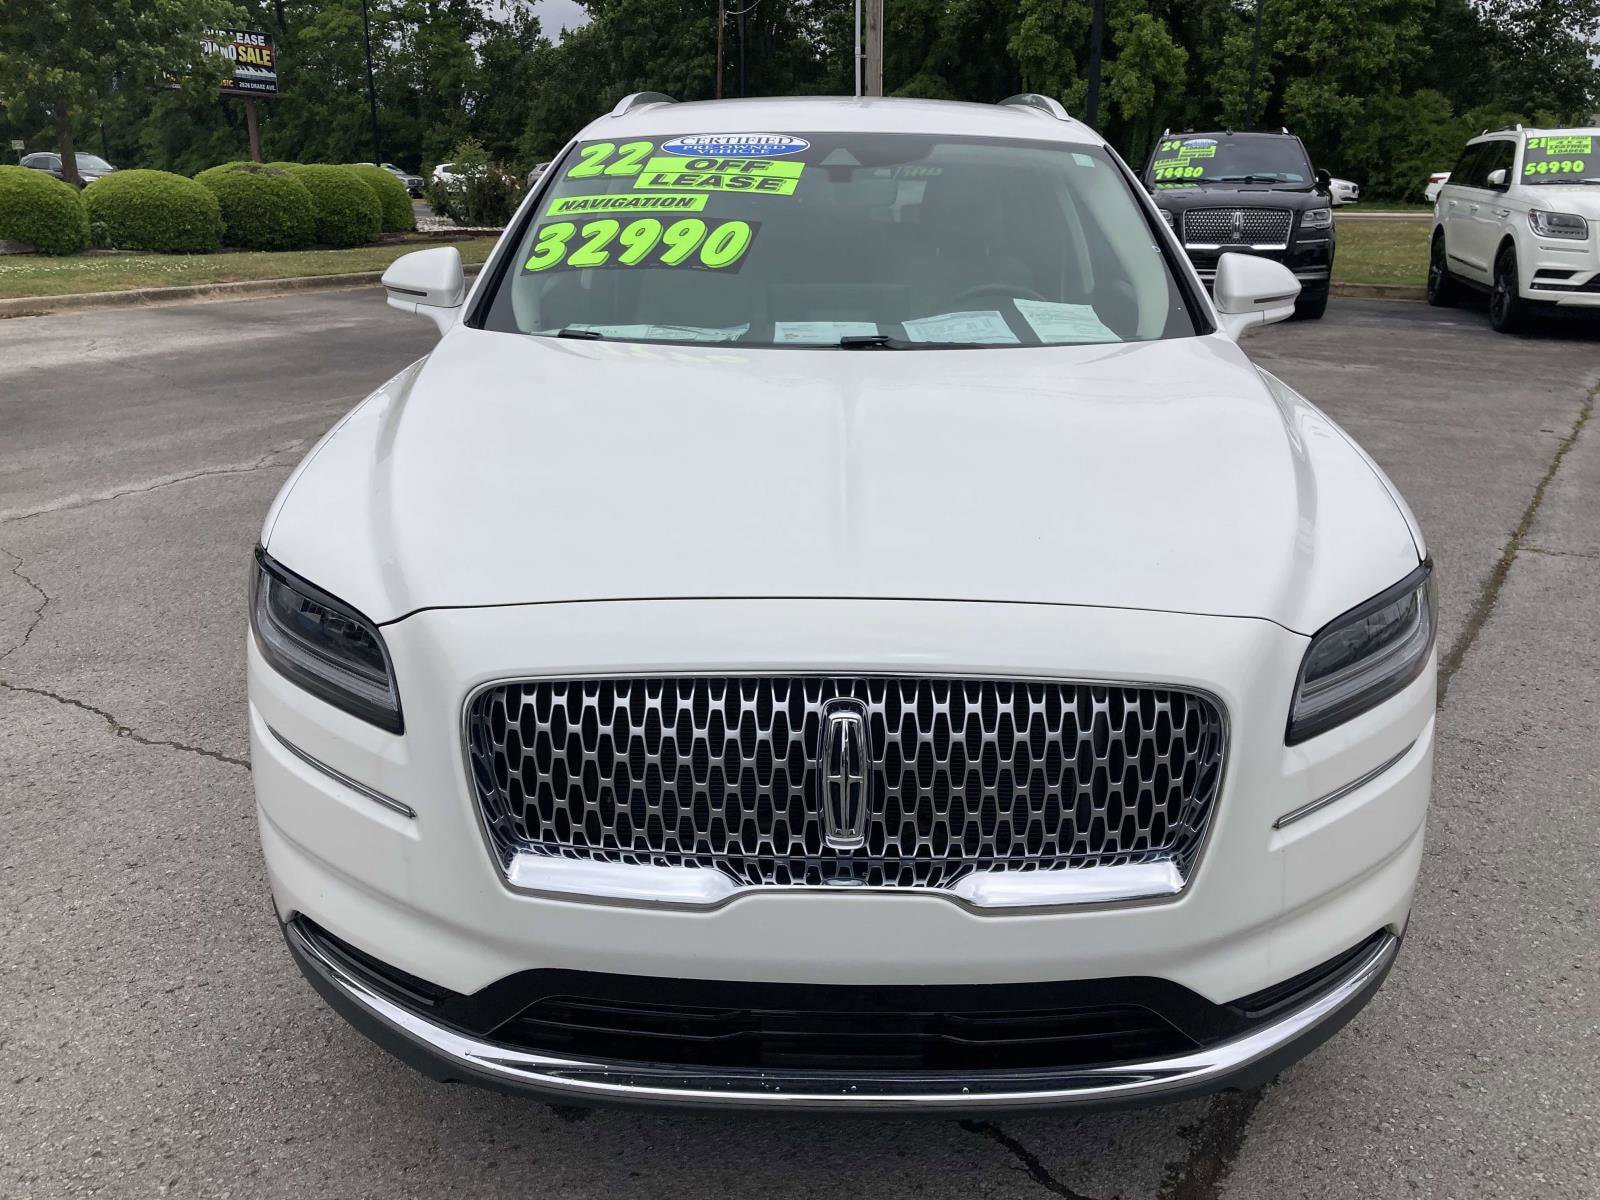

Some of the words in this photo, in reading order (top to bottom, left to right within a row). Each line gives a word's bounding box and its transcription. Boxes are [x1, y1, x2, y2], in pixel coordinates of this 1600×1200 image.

[238, 45, 272, 66] SALE
[680, 136, 794, 145] CERTIFIED
[1161, 141, 1181, 152] 24
[1527, 138, 1547, 150] 21
[566, 141, 655, 178] 22
[685, 158, 774, 173] OFF
[1524, 159, 1585, 176] 54990
[648, 173, 787, 193] LEASE
[557, 196, 697, 213] NAVIGATION
[525, 217, 753, 272] 32990
